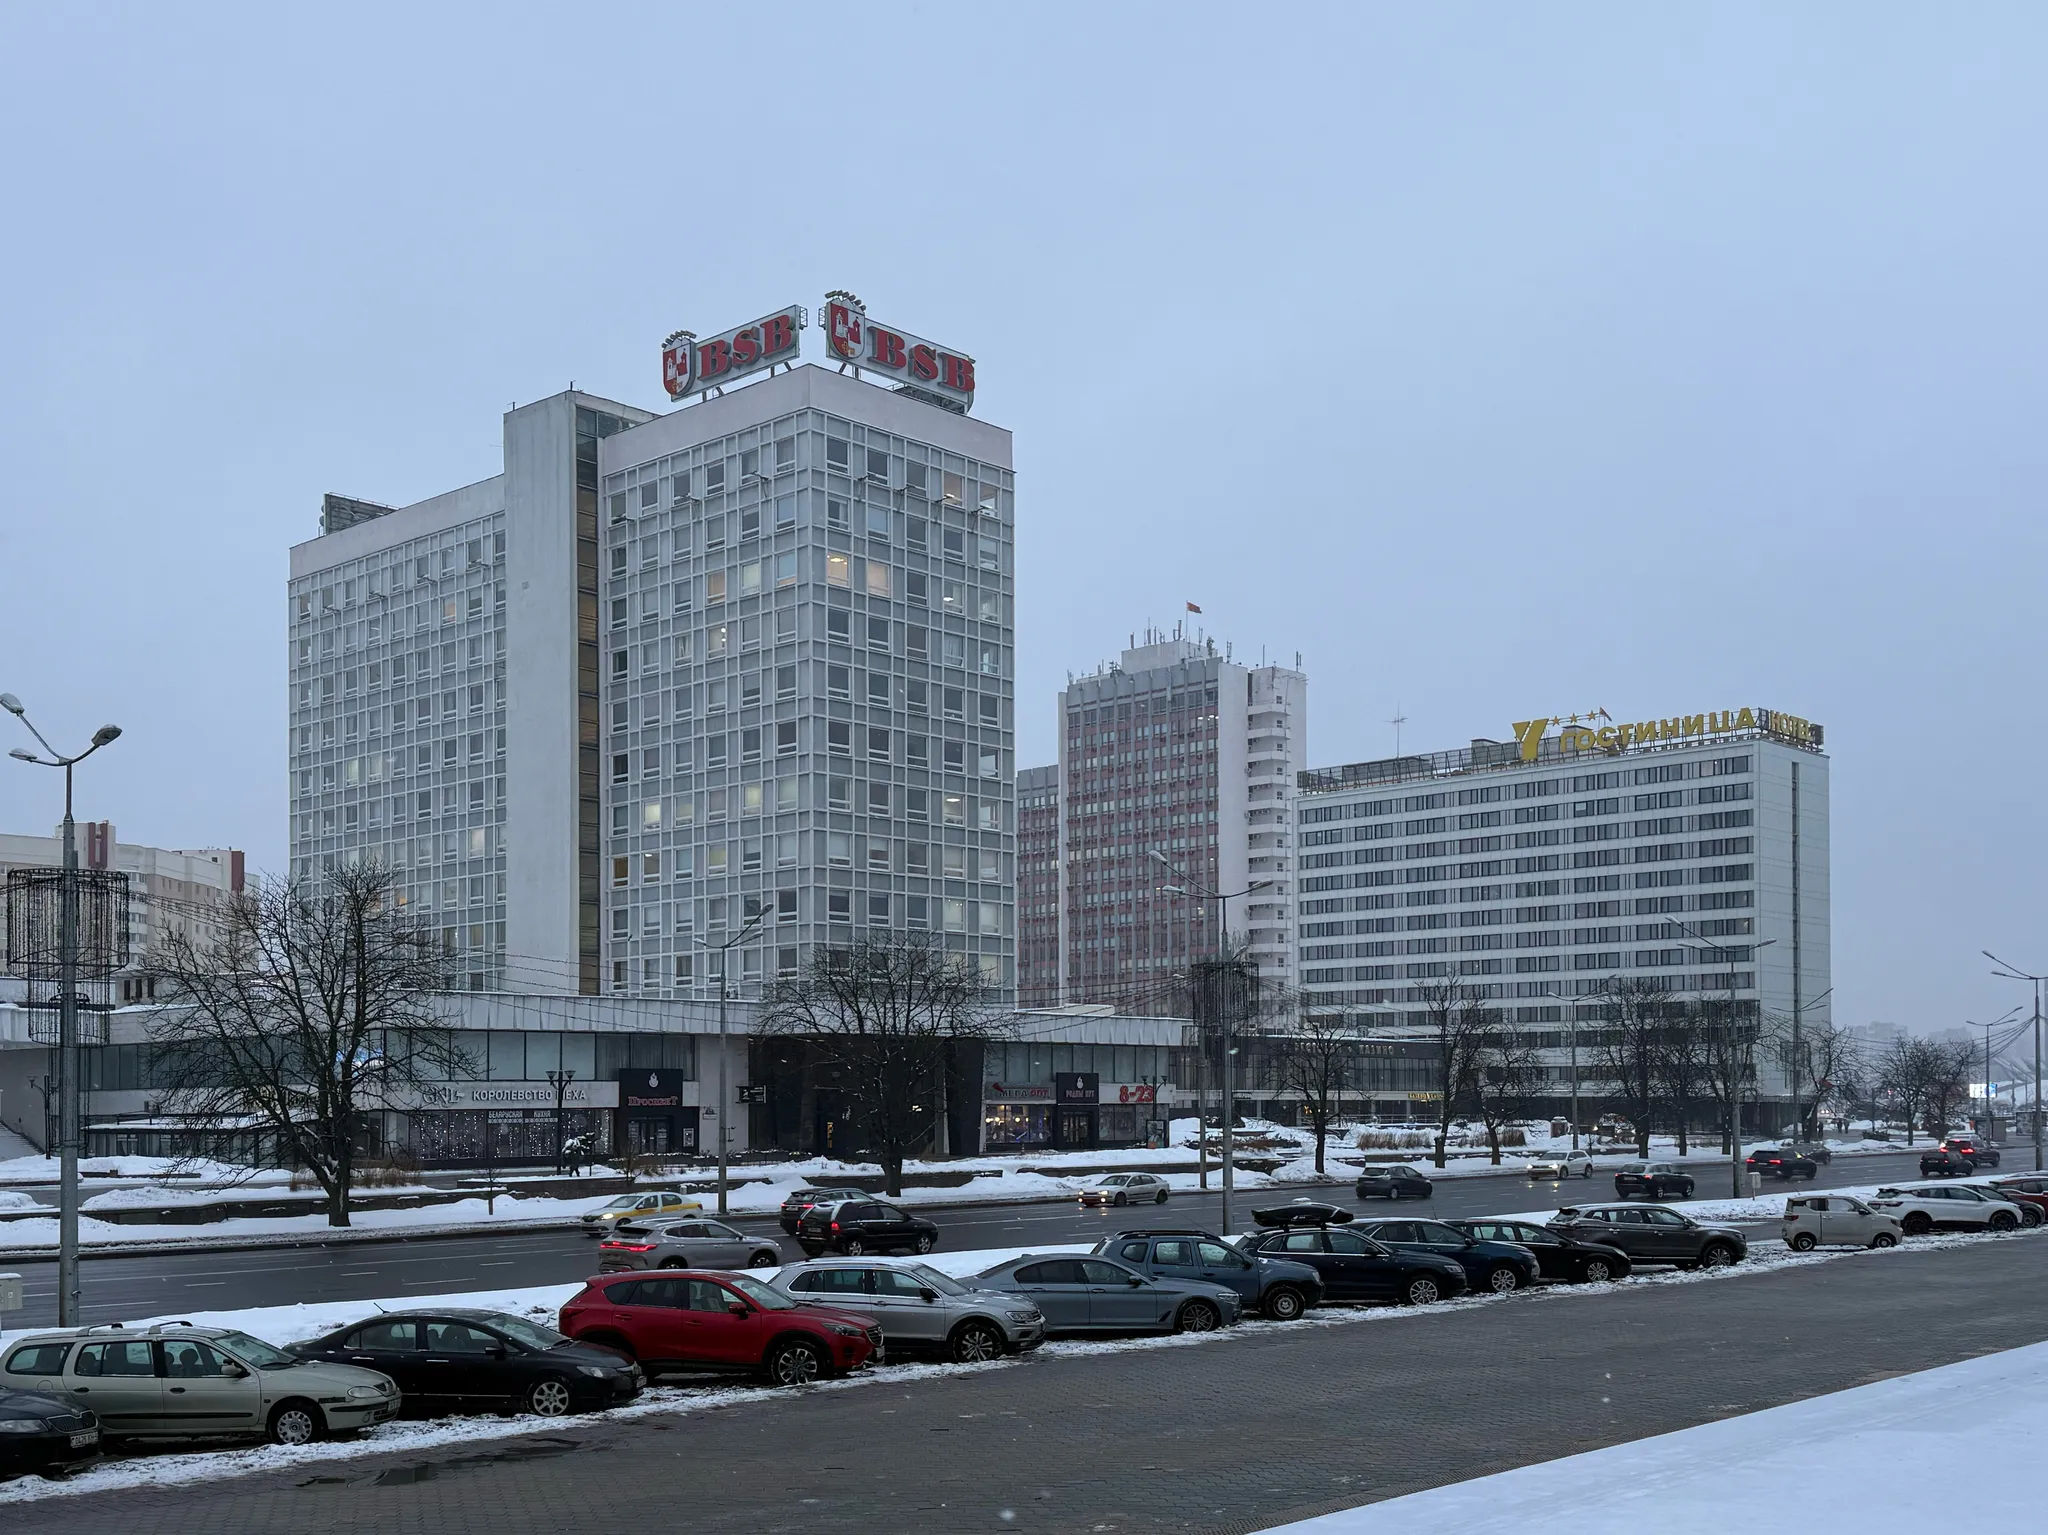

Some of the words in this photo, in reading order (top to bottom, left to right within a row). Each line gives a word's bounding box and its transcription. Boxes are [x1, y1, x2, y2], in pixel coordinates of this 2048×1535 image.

[697, 313, 794, 381] BSB
[867, 326, 976, 393] BSB
[1560, 707, 1756, 753] ГОСТИНИЦА
[473, 1090, 552, 1101] КОРОЛЕВСТВО
[1119, 1085, 1153, 1103] 8-23
